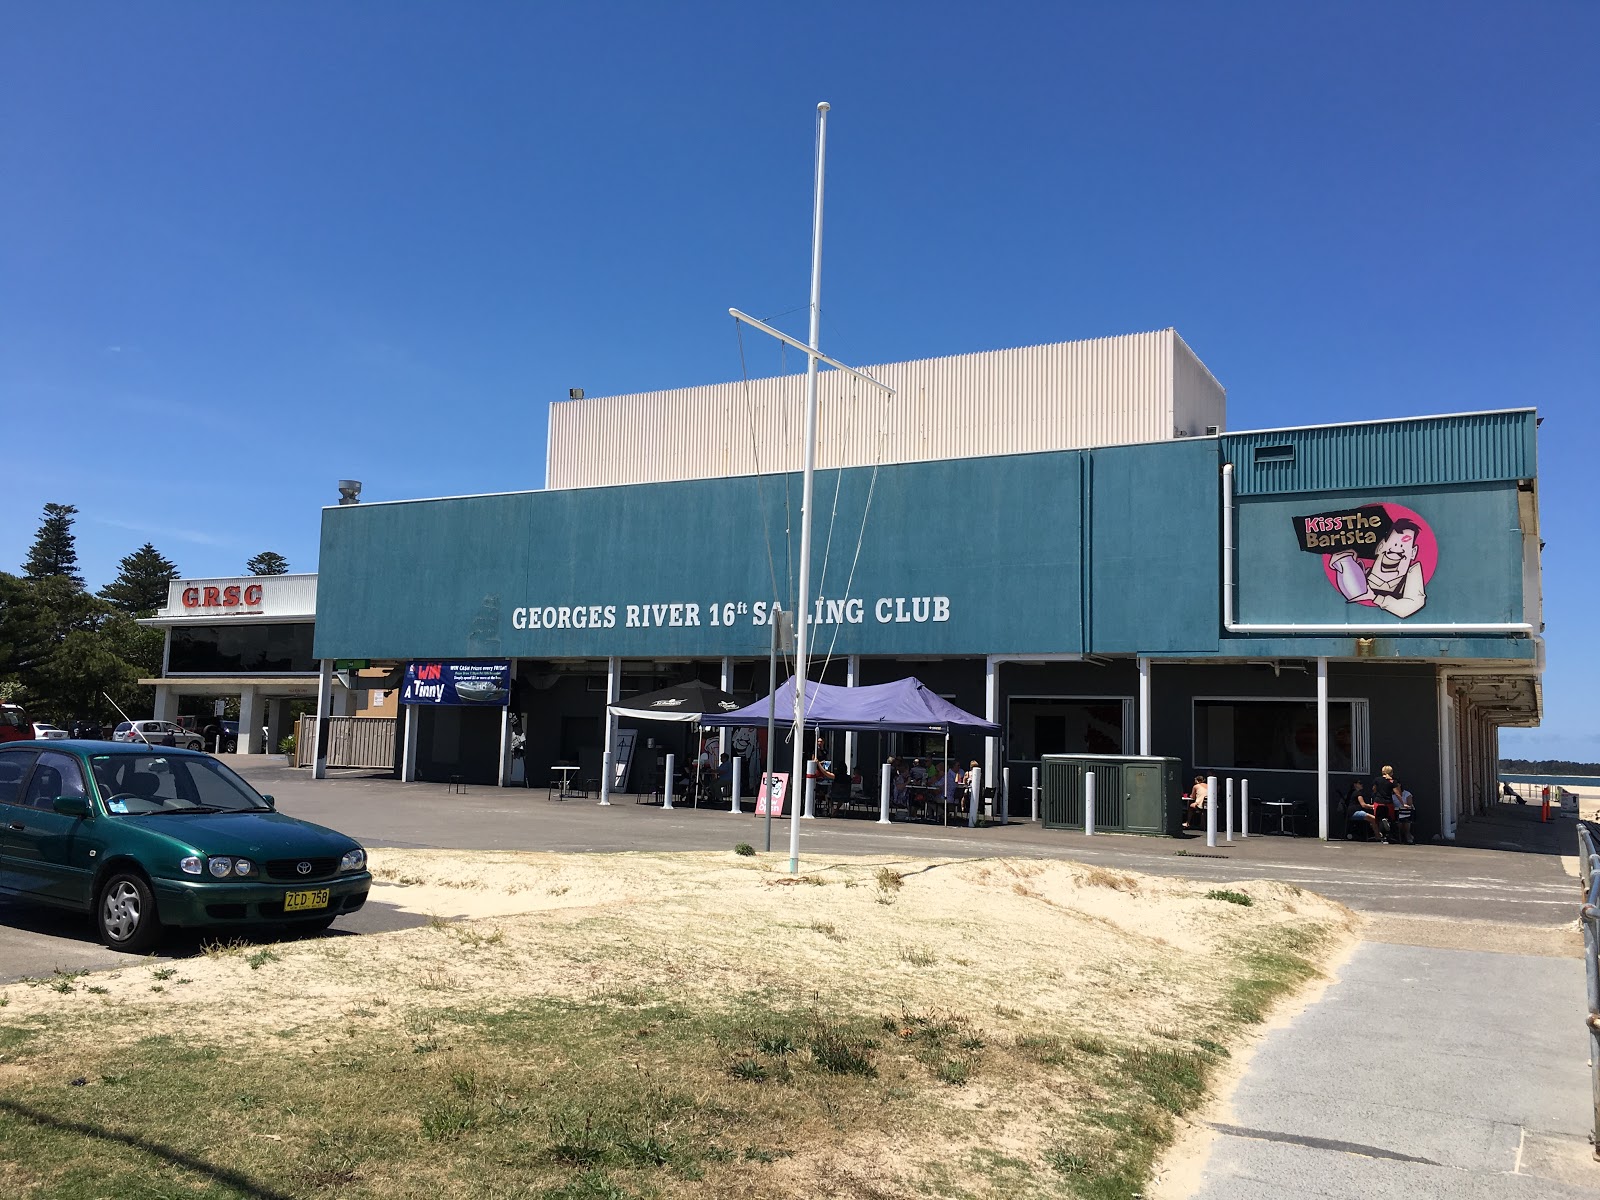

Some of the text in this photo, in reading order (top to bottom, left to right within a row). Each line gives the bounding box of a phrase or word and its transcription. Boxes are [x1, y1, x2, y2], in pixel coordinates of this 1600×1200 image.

[1304, 513, 1382, 533] Kiss The
[1305, 530, 1377, 548] Barista
[512, 605, 616, 629] GEORGES
[625, 603, 701, 628] RIVER
[752, 598, 864, 626] SAING
[875, 596, 950, 623] CLUB
[418, 663, 442, 679] WIN
[404, 685, 411, 699] A
[413, 680, 445, 703] Tinny
[760, 797, 778, 805] Nw
